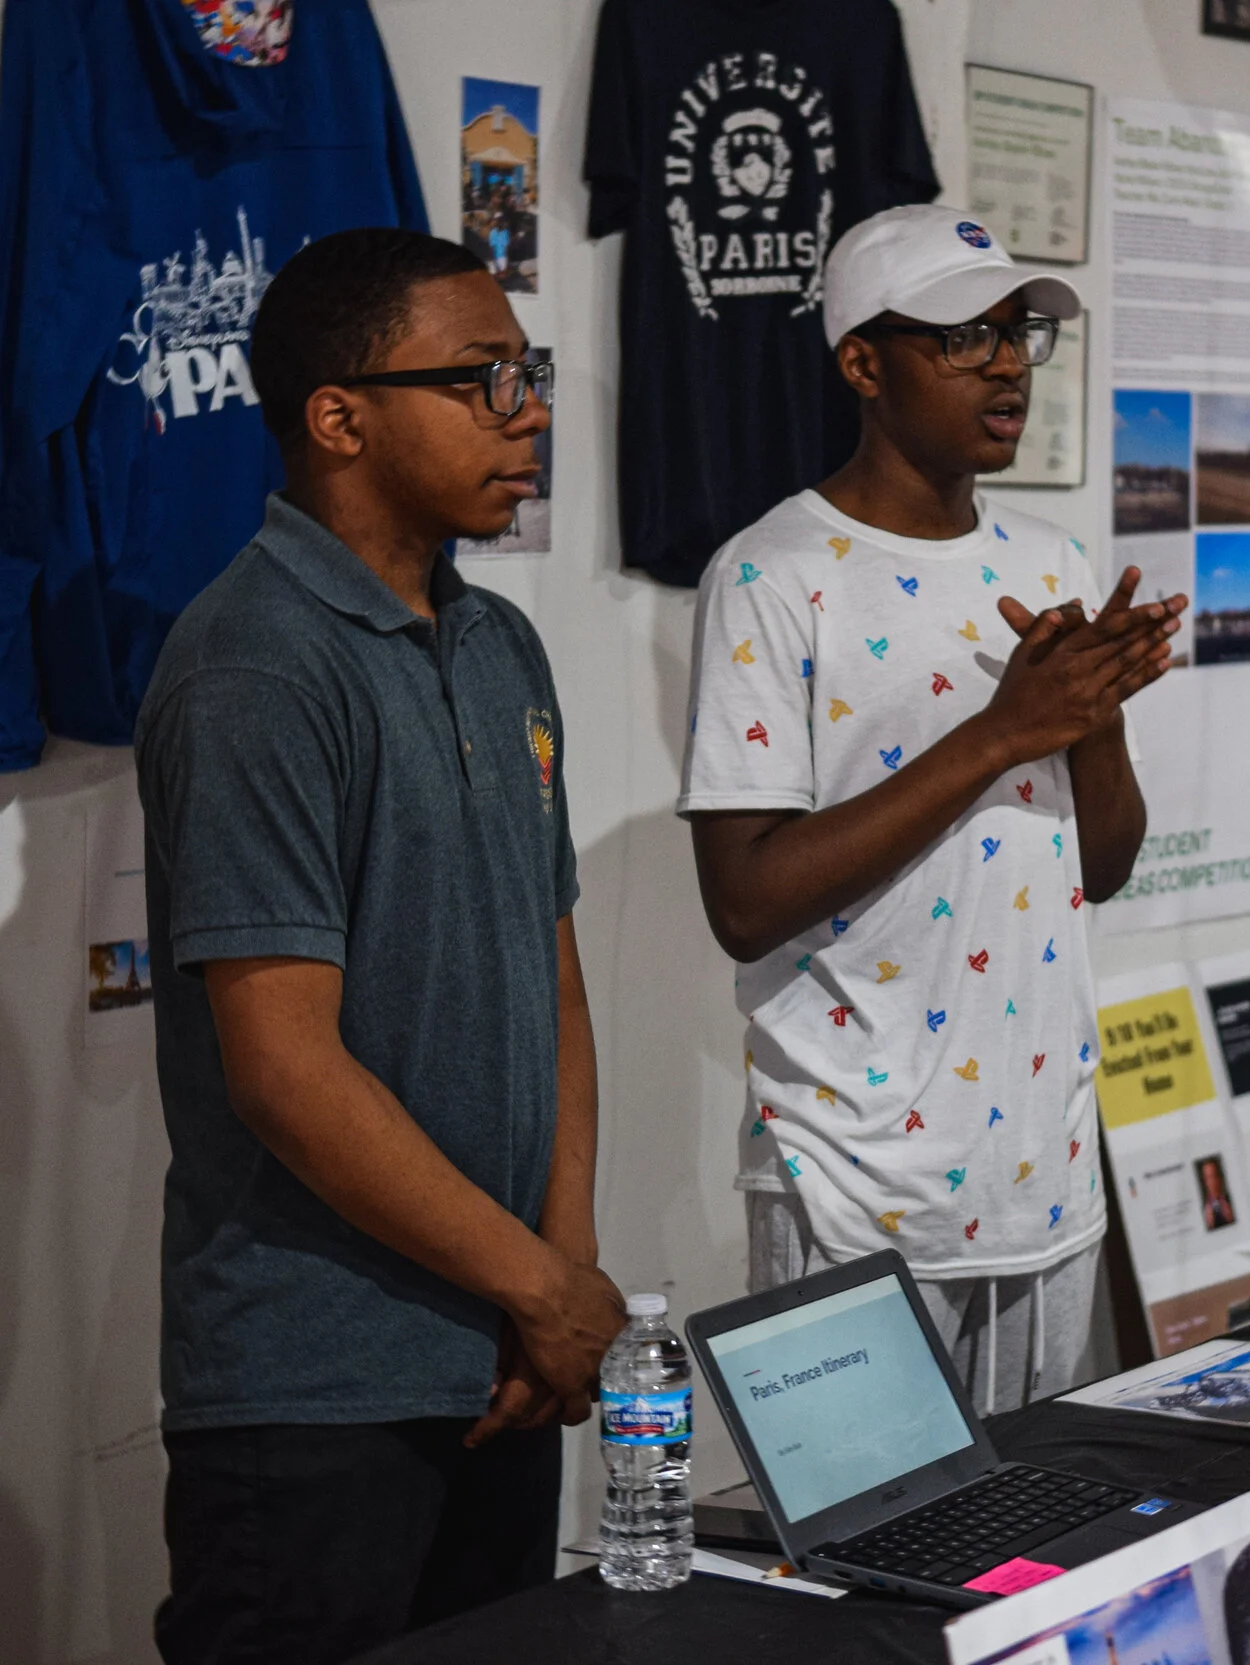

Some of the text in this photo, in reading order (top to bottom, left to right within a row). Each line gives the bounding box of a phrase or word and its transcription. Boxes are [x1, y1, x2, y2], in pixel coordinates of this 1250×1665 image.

[699, 232, 816, 271] PARIS
[165, 342, 261, 418] PA
[1138, 827, 1213, 862] STUDENT
[749, 1348, 869, 1401] Paris, France Itinerary
[622, 1411, 671, 1425] MOUNTAIN
